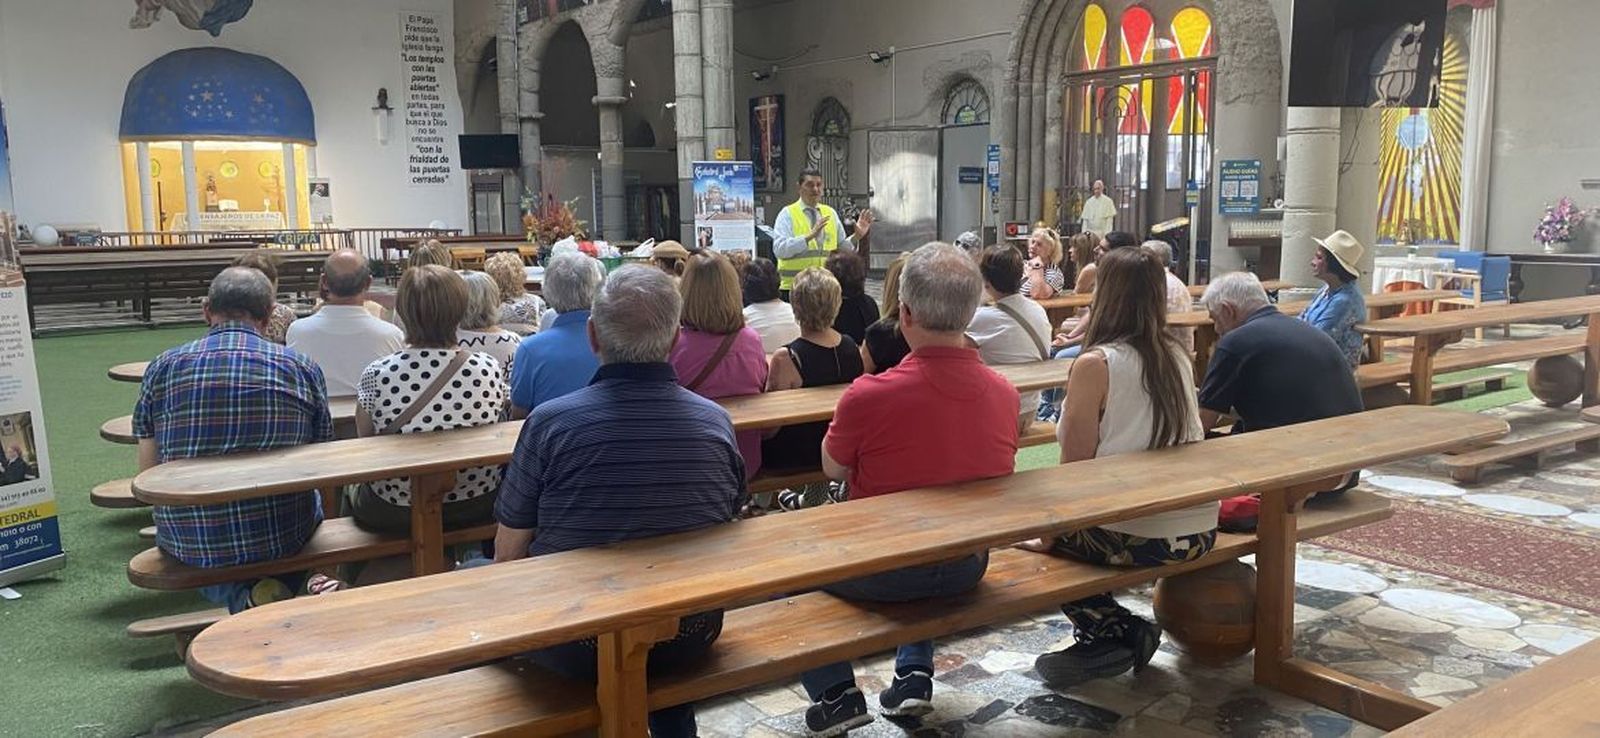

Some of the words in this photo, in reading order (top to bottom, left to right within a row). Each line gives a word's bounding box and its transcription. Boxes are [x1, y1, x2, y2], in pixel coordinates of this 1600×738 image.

[405, 23, 439, 34] Francisco
[418, 54, 445, 64] templos
[411, 64, 425, 73] con
[425, 64, 436, 73] las
[411, 74, 437, 83] puertas
[420, 93, 440, 101] todas
[409, 111, 422, 119] que
[430, 111, 444, 120] que
[405, 118, 426, 126] busca
[432, 118, 448, 127] Dios
[417, 127, 428, 135] no
[428, 127, 437, 135] se
[435, 144, 443, 154] la
[409, 154, 439, 164] frialdad
[439, 155, 450, 164] de
[409, 164, 421, 174] las
[421, 165, 451, 175] puertas
[277, 233, 318, 244] CRIPTA
[27, 522, 42, 532] con
